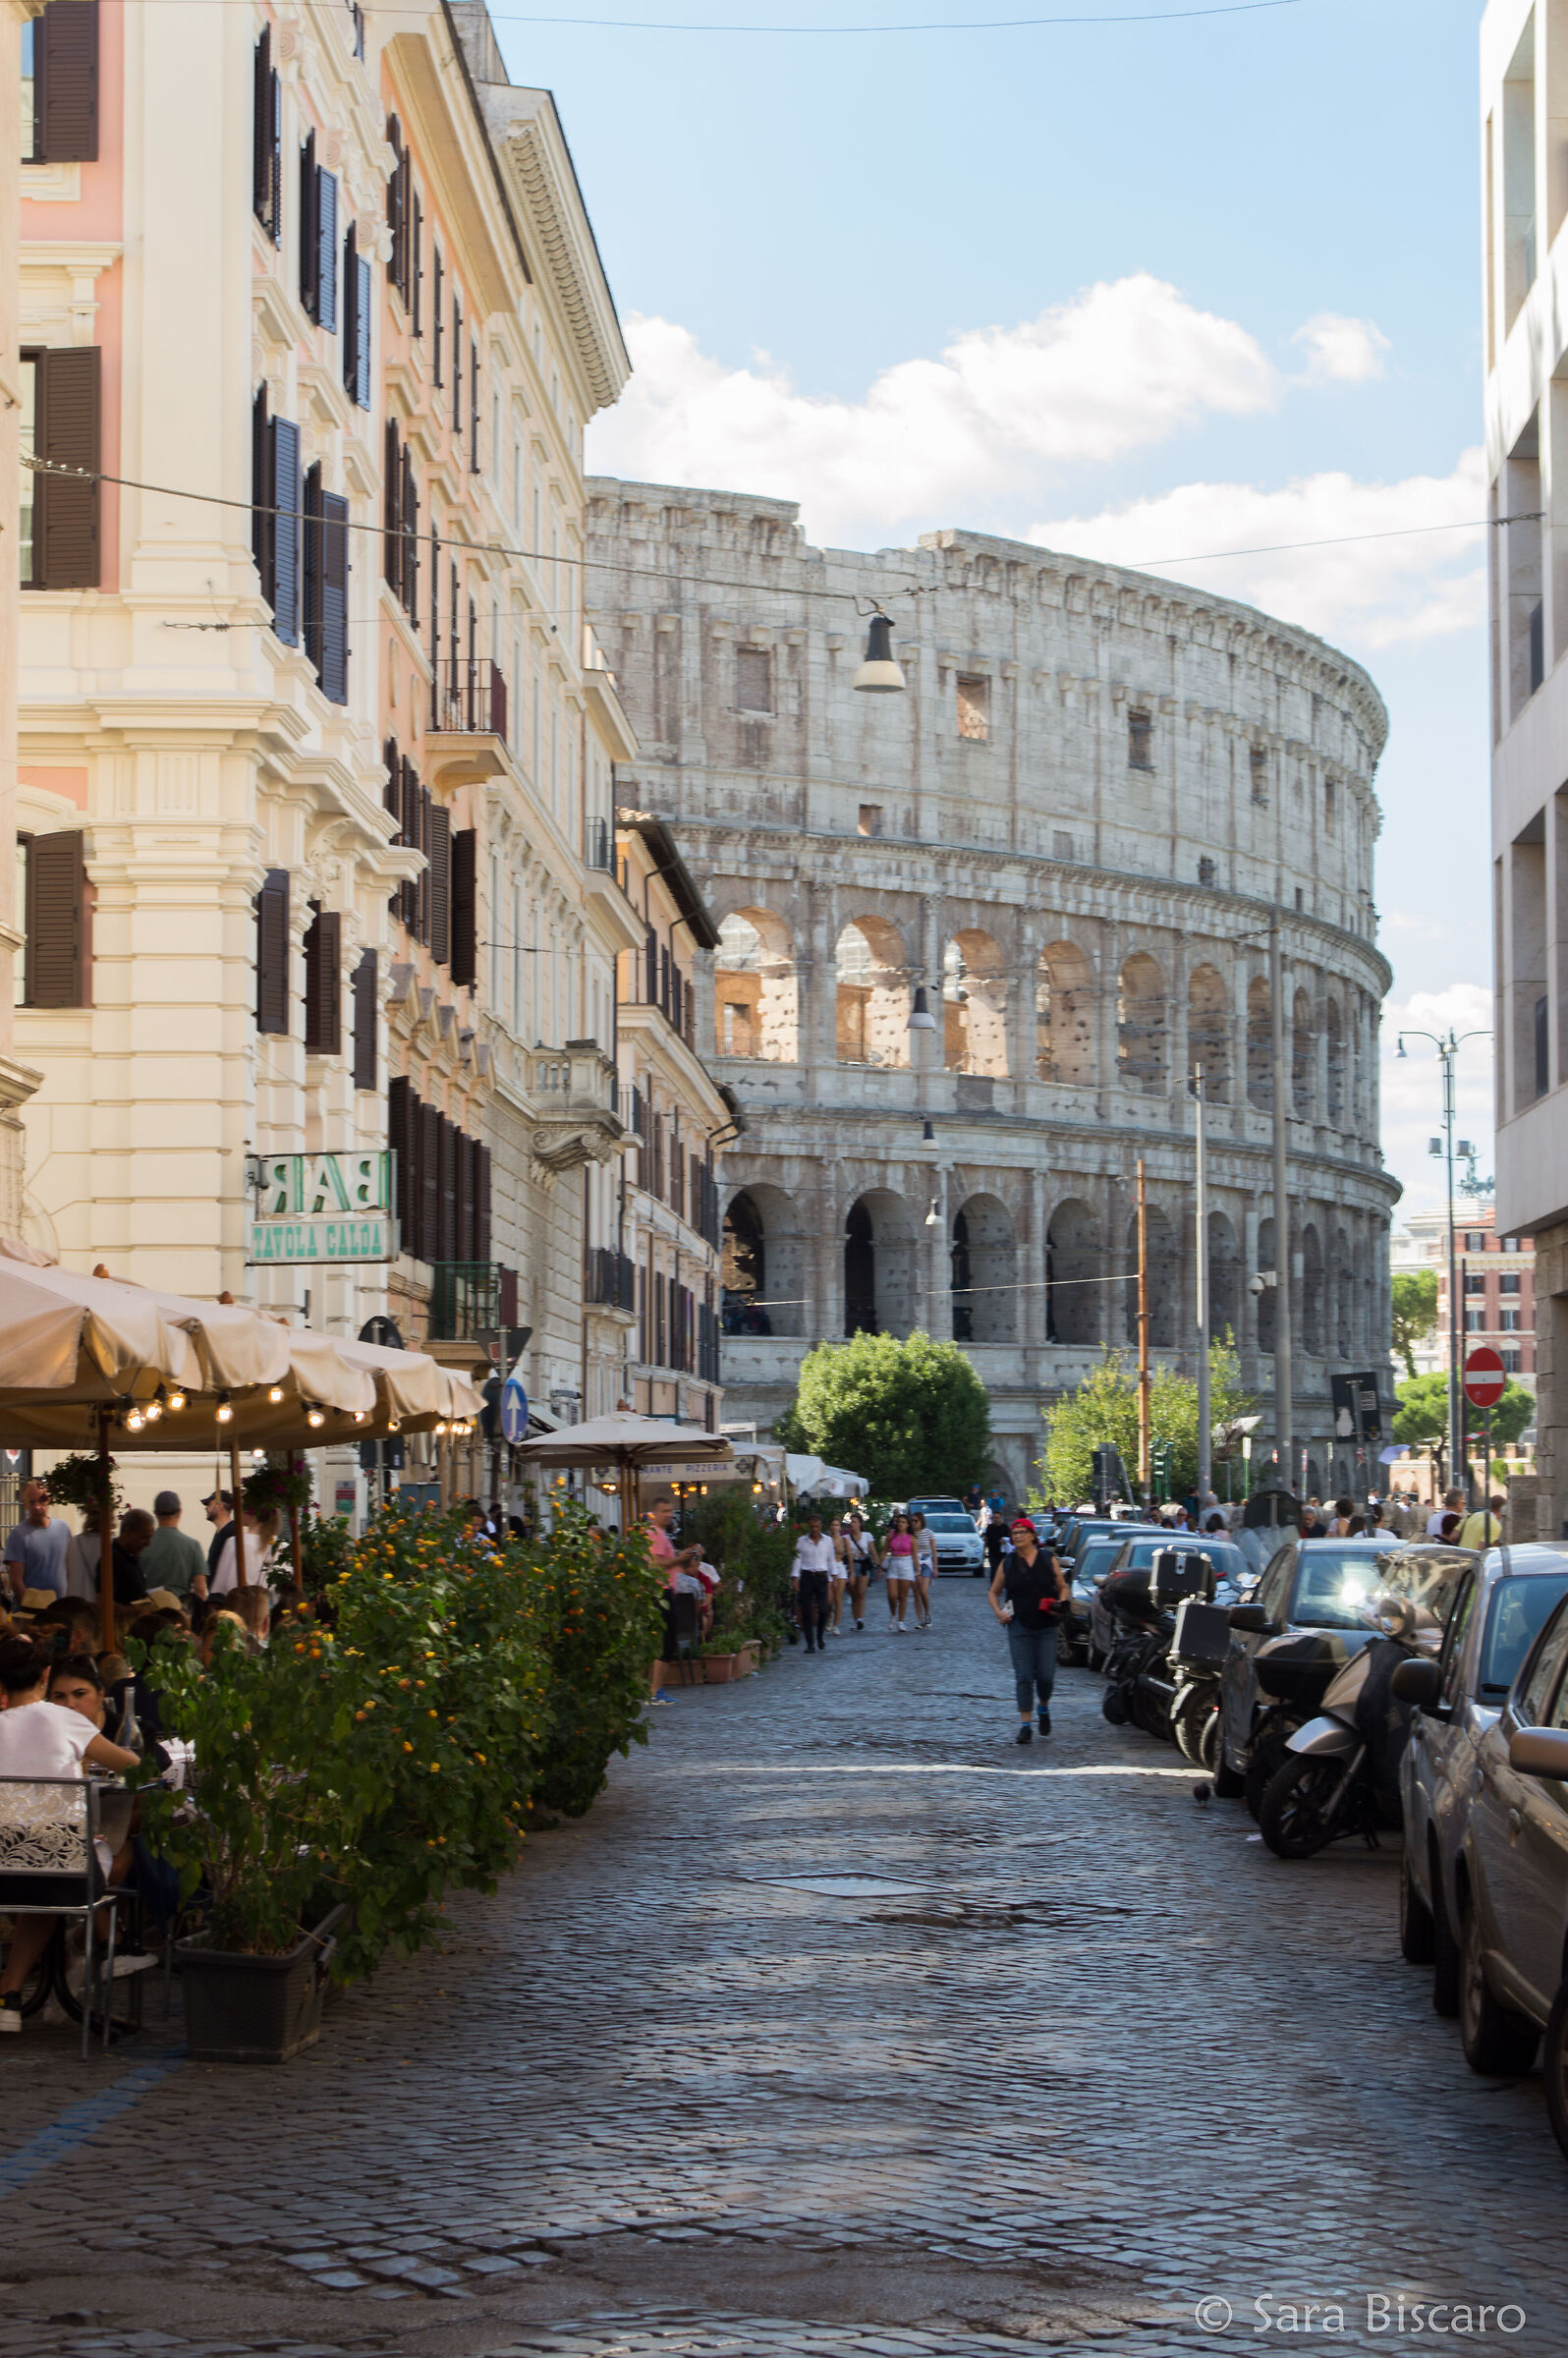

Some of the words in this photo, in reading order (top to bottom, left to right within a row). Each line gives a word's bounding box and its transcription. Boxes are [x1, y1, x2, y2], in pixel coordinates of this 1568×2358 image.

[252, 1225, 317, 1259] TAVOLA
[326, 1223, 382, 1257] CALDA
[686, 1463, 728, 1473] PIZZERIA
